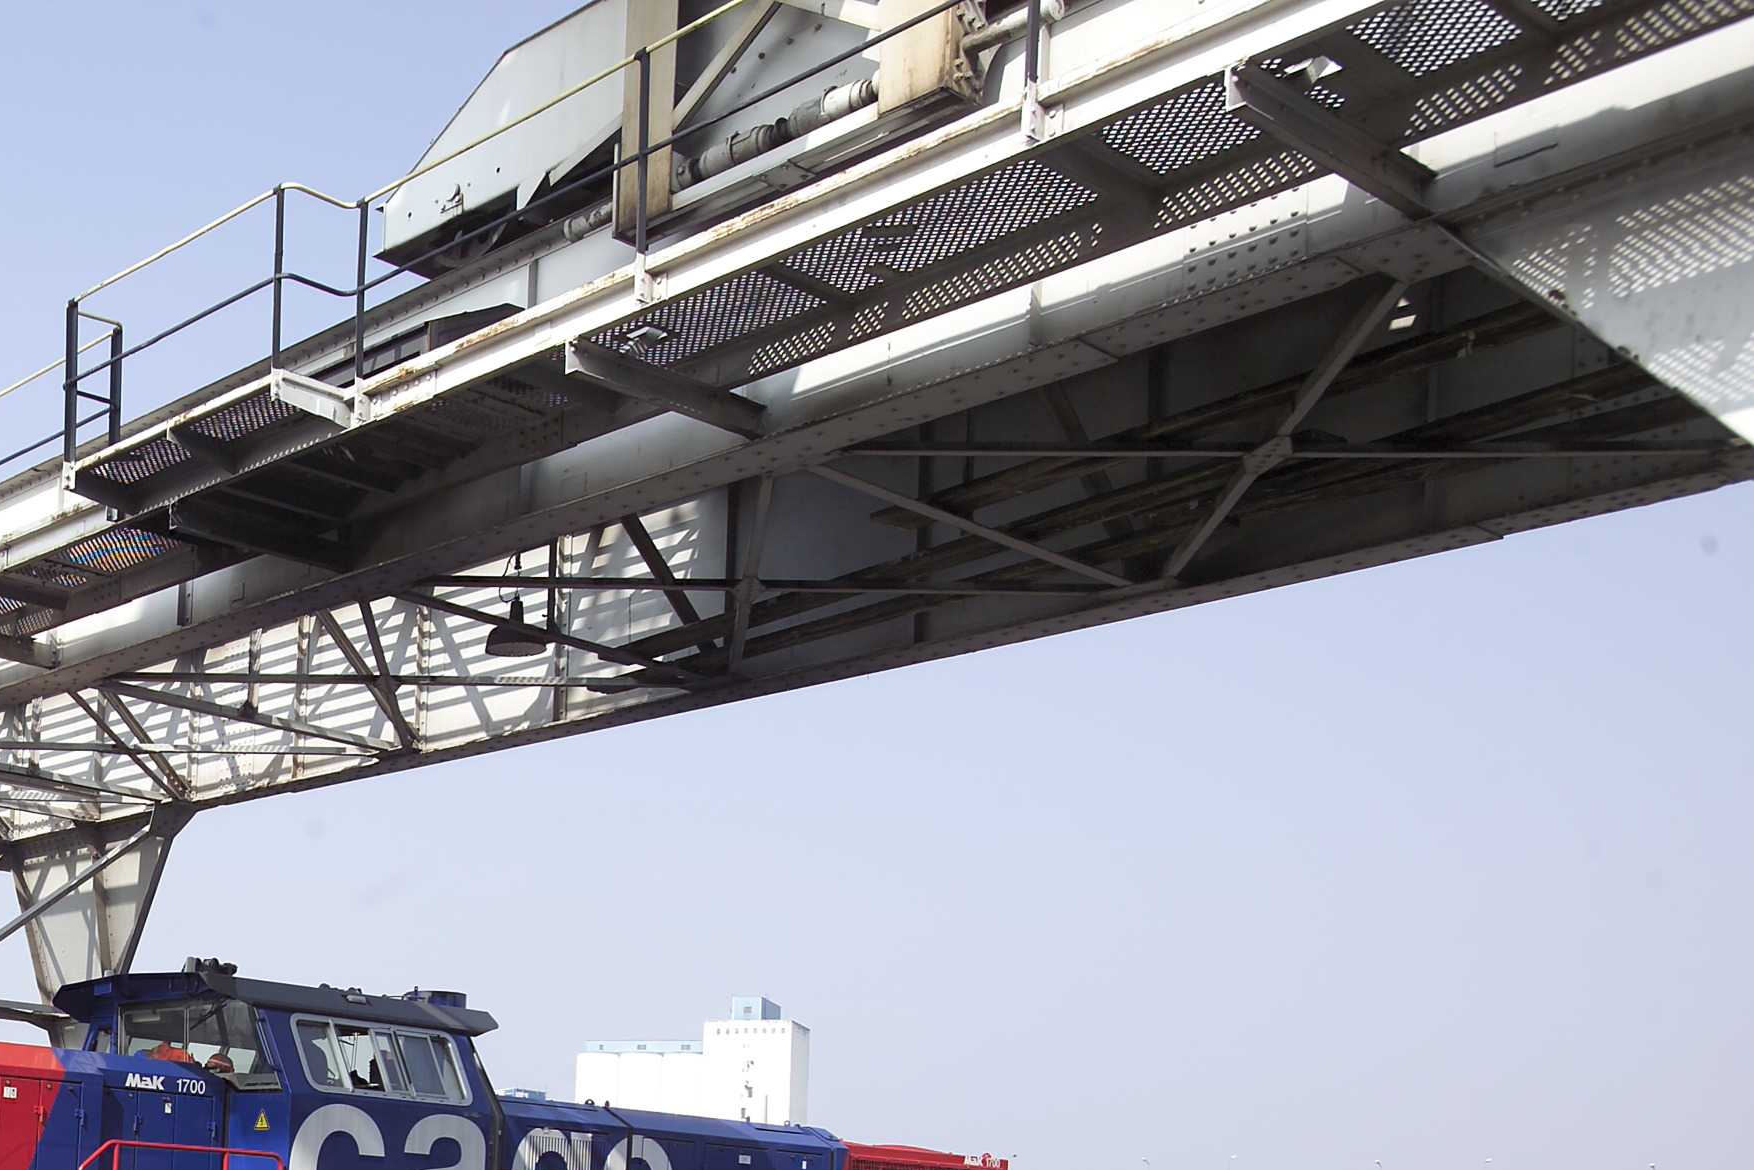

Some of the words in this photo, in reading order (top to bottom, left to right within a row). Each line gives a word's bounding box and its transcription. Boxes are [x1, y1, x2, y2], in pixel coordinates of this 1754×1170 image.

[125, 1072, 165, 1090] MaK
[176, 1078, 206, 1095] 1700
[986, 1157, 1001, 1168] 1700
